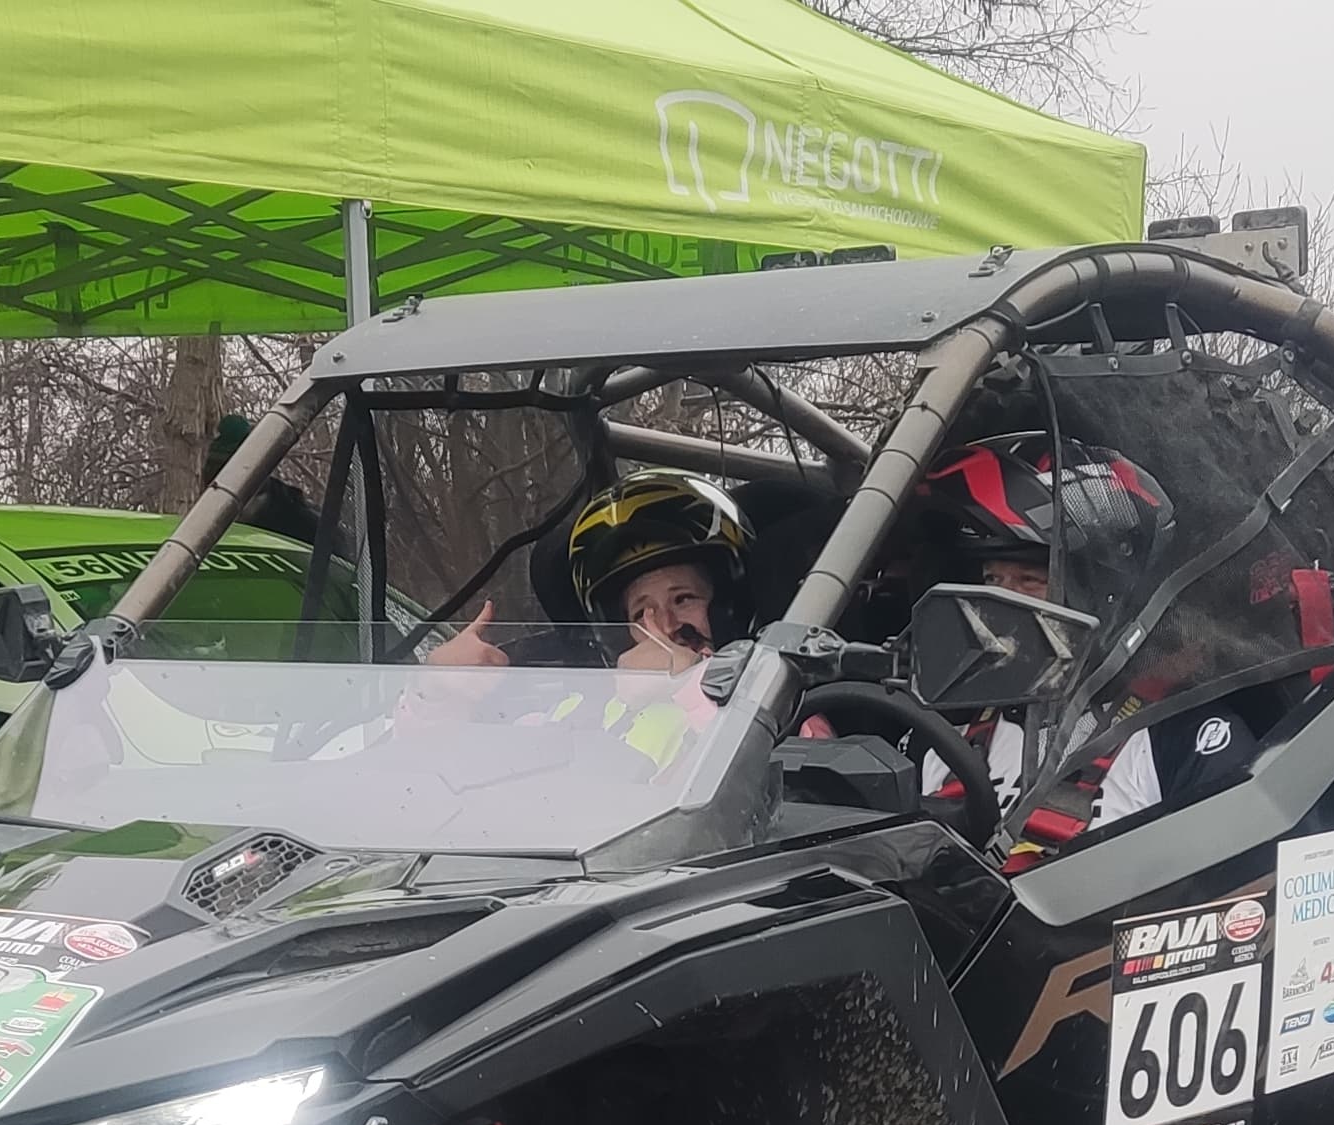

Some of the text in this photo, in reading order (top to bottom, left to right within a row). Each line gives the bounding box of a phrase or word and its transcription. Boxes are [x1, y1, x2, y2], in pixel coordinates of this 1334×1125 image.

[762, 119, 943, 205] NEGOTTI
[54, 550, 304, 578] 56 NEOTTI
[1163, 944, 1218, 969] promo
[1119, 981, 1249, 1119] 606
